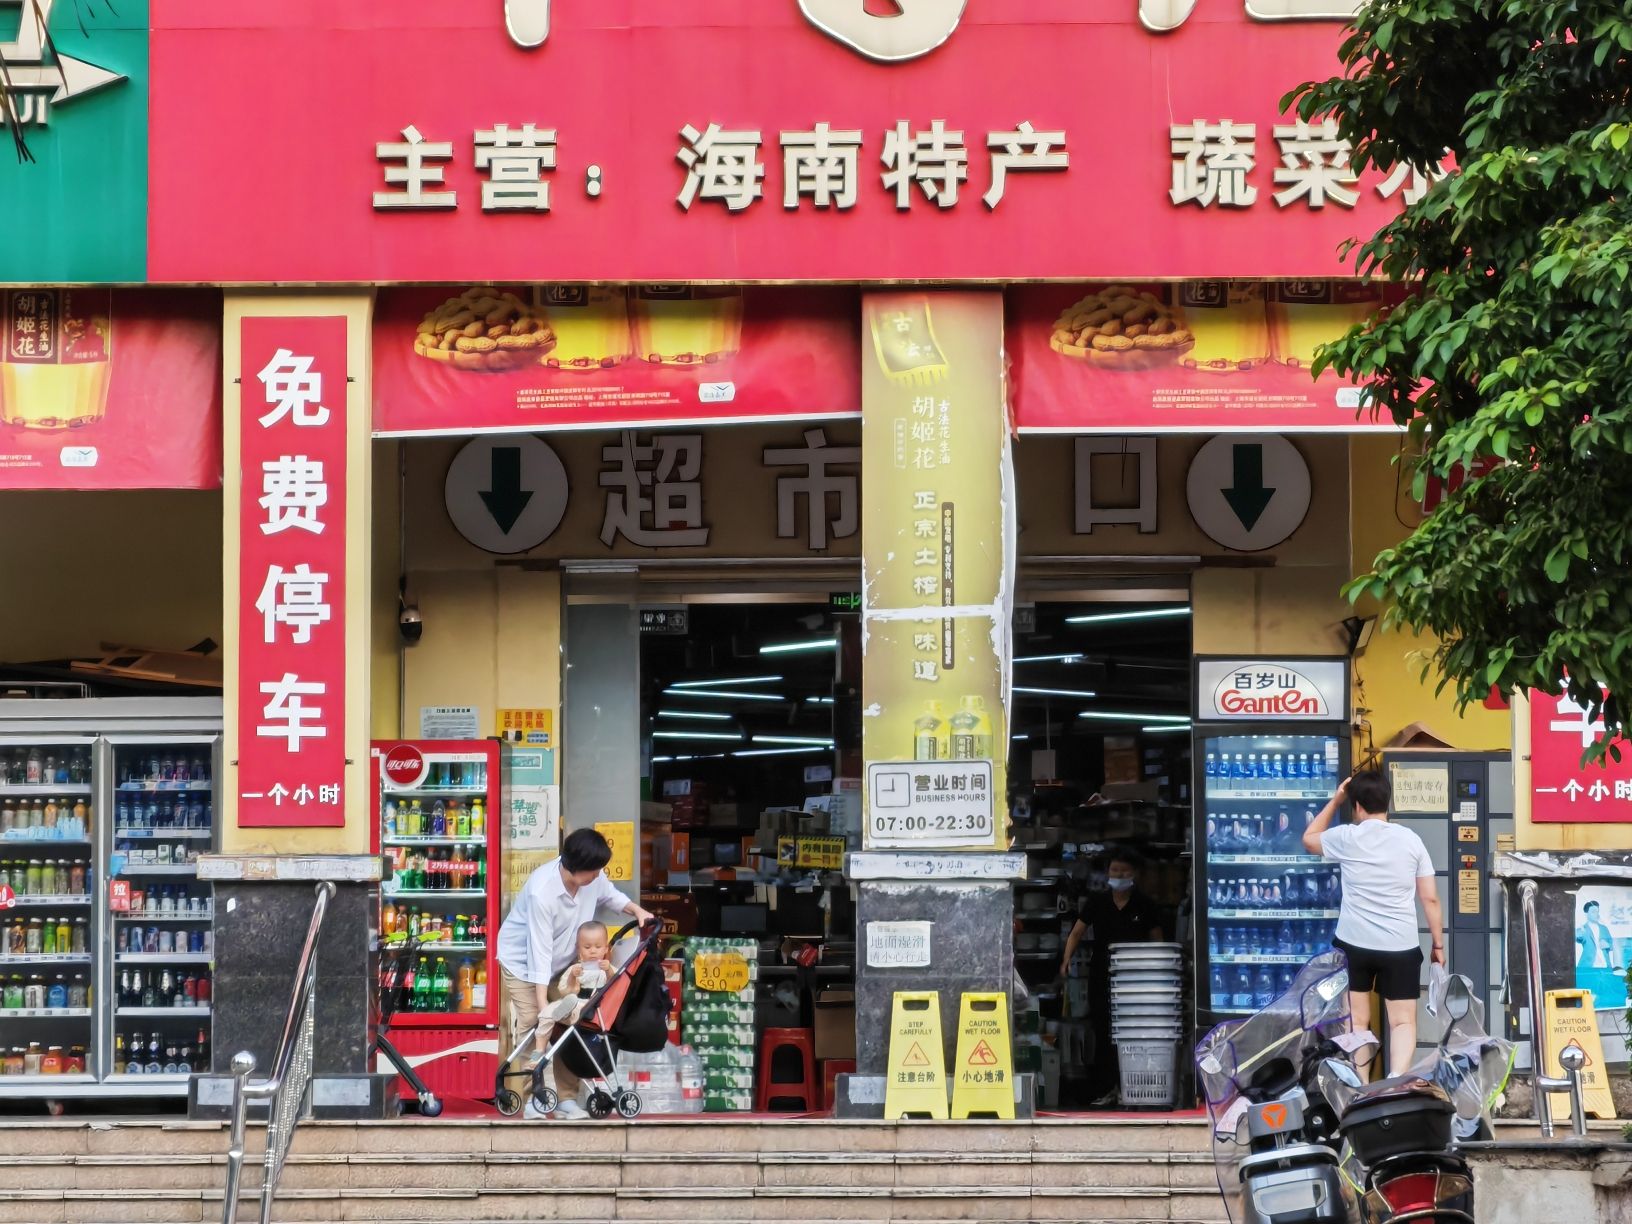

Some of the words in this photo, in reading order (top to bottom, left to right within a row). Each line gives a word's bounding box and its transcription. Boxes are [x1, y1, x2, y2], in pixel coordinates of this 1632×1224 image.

[676, 118, 1070, 212] 海南特产
[16, 296, 36, 355] 胡姬花
[911, 396, 937, 470] 胡姬花
[938, 400, 951, 465] 古法花生油
[255, 348, 331, 753] 免费停车
[912, 490, 938, 682] 正宗土榨味道
[1234, 672, 1297, 689] 百岁山
[241, 782, 341, 806] 一个小时
[914, 774, 986, 792] 营业时间
[1535, 778, 1632, 802] 一个小时
[915, 793, 956, 803] BUSINESS
[957, 792, 986, 802] HOURS
[876, 814, 986, 832] 07:00-22:30
[870, 935, 924, 949] 地面湿滑
[897, 1071, 935, 1083] 注意台阶
[962, 1069, 1005, 1083] 小心地滑
